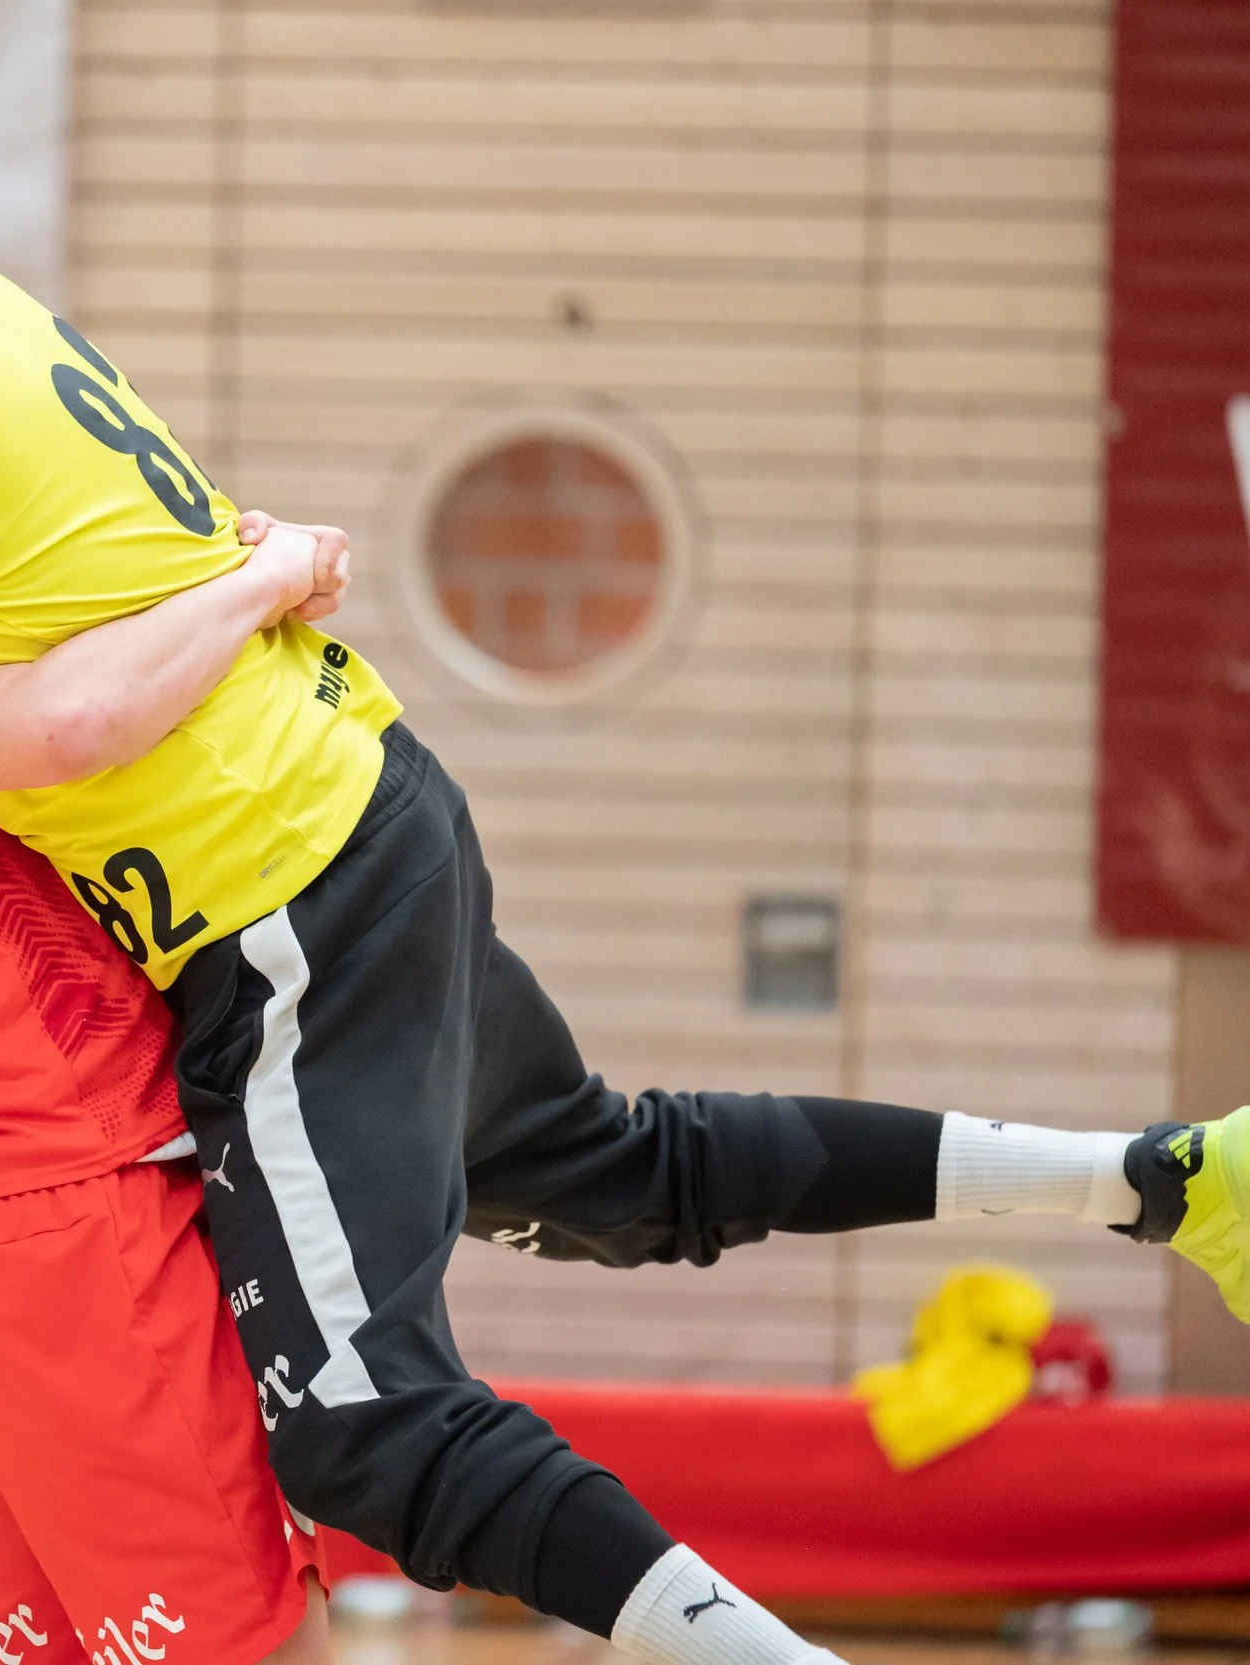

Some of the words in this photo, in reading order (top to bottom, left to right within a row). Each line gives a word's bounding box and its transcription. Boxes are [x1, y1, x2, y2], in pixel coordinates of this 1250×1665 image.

[51, 314, 217, 537] 8
[71, 847, 210, 965] 82
[230, 1279, 264, 1320] GIE
